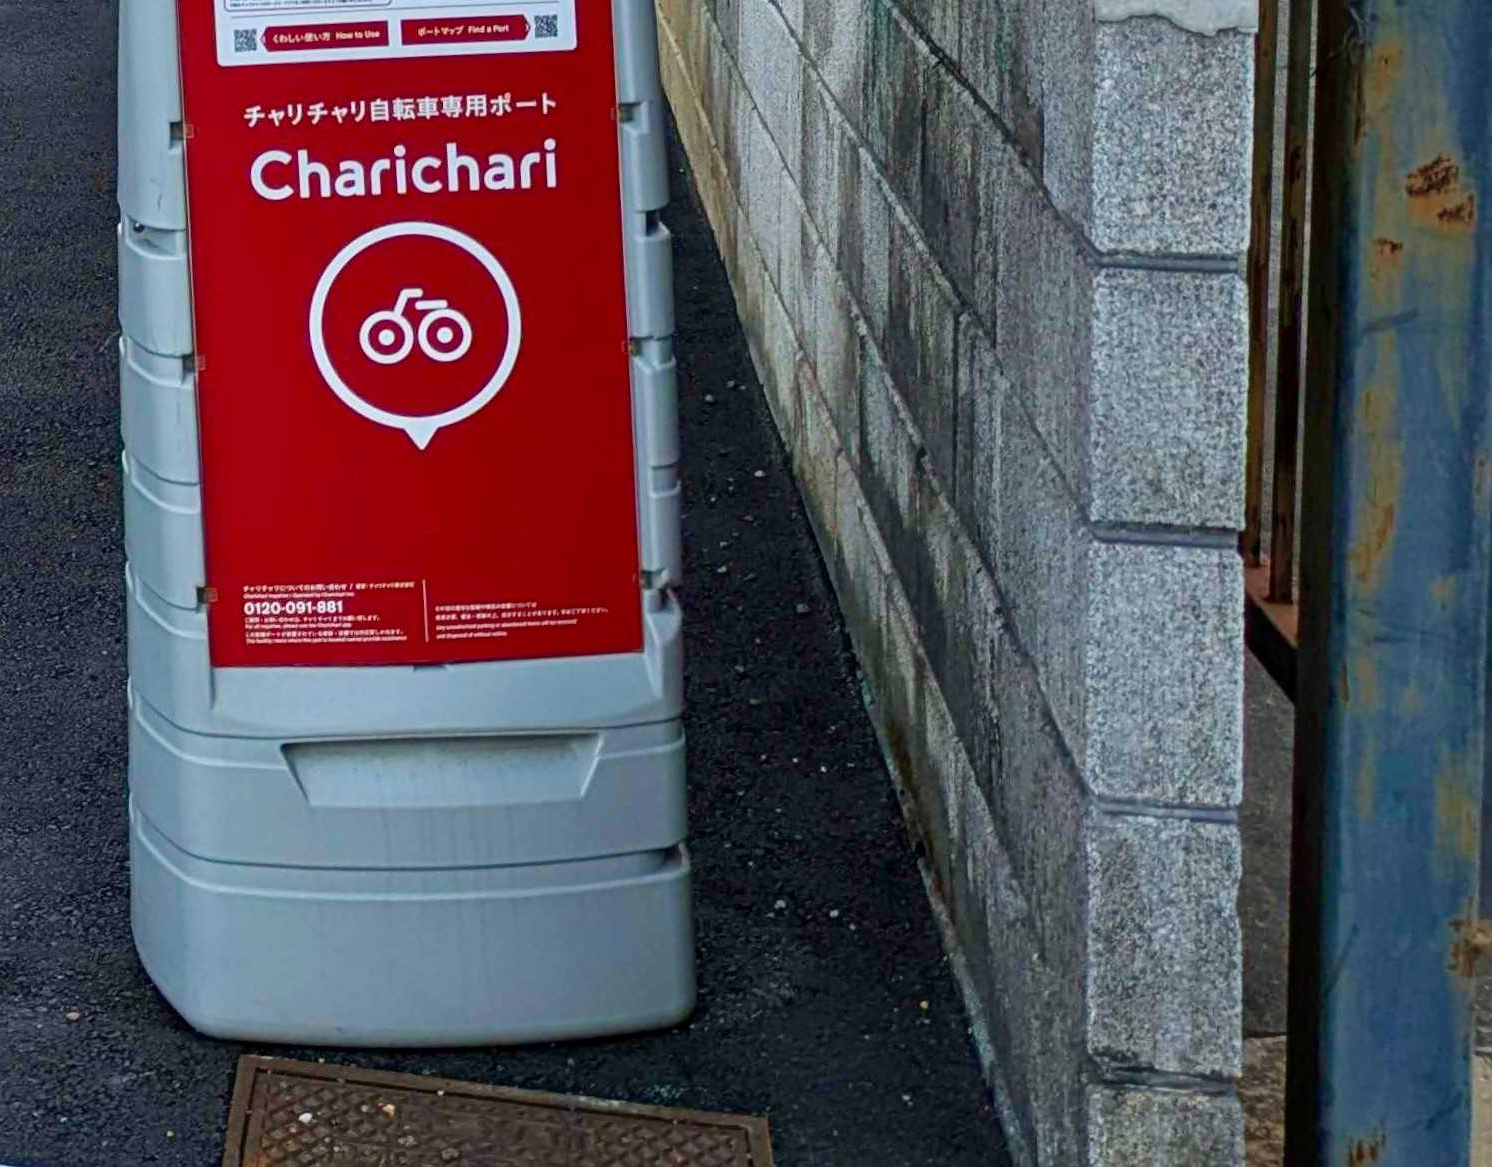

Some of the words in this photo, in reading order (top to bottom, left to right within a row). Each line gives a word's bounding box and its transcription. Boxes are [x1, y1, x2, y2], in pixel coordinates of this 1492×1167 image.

[272, 31, 331, 43] くわしい使い方
[336, 32, 354, 40] How
[355, 31, 364, 39] to
[365, 30, 380, 39] Use
[418, 26, 464, 37] ポートマップ
[468, 25, 485, 34] Find
[493, 24, 510, 33] Port
[243, 92, 557, 127] チャリチャリ自転車専用ポート
[250, 138, 557, 201] Charichari
[243, 600, 344, 615] 0120-091-881
